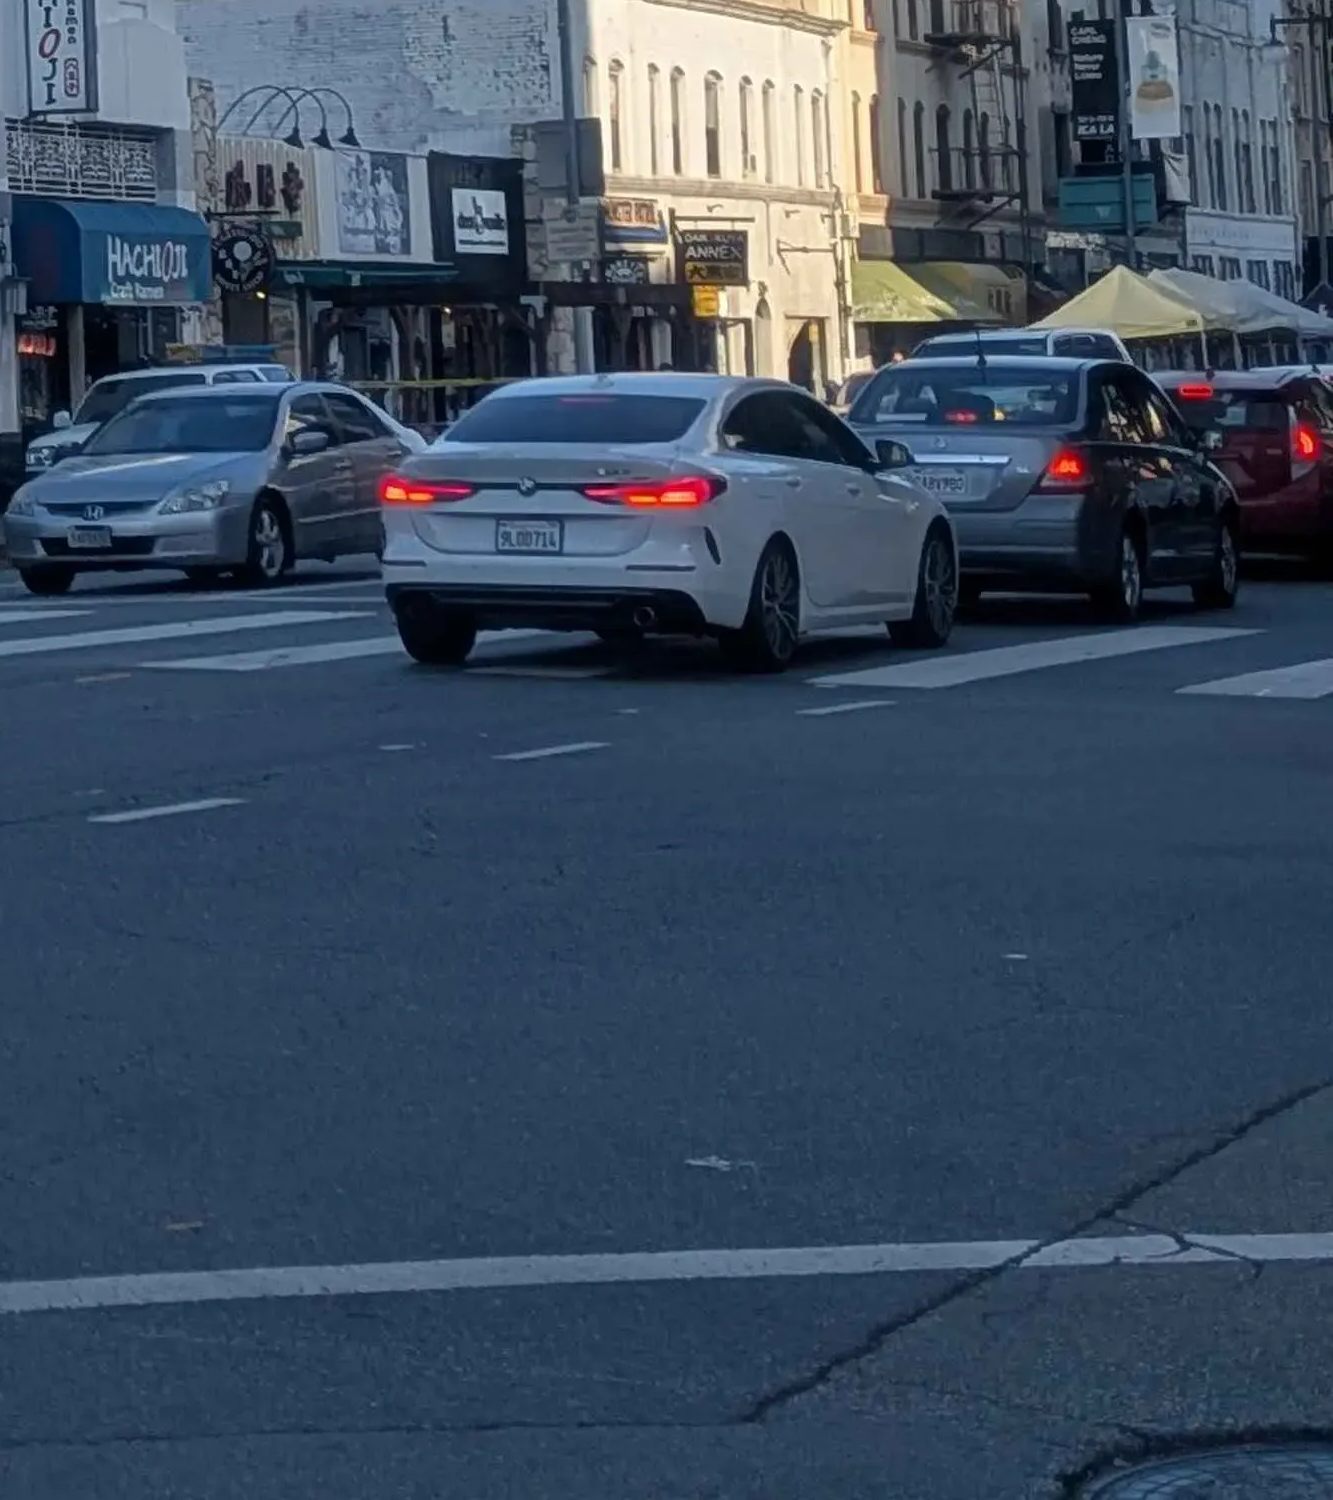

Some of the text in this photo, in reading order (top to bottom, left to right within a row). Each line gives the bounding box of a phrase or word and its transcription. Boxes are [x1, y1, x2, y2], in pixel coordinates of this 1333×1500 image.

[107, 234, 188, 283] HACHIOJI
[685, 246, 742, 259] ANNEX
[110, 281, 133, 298] Craft
[134, 282, 164, 299] Ramen
